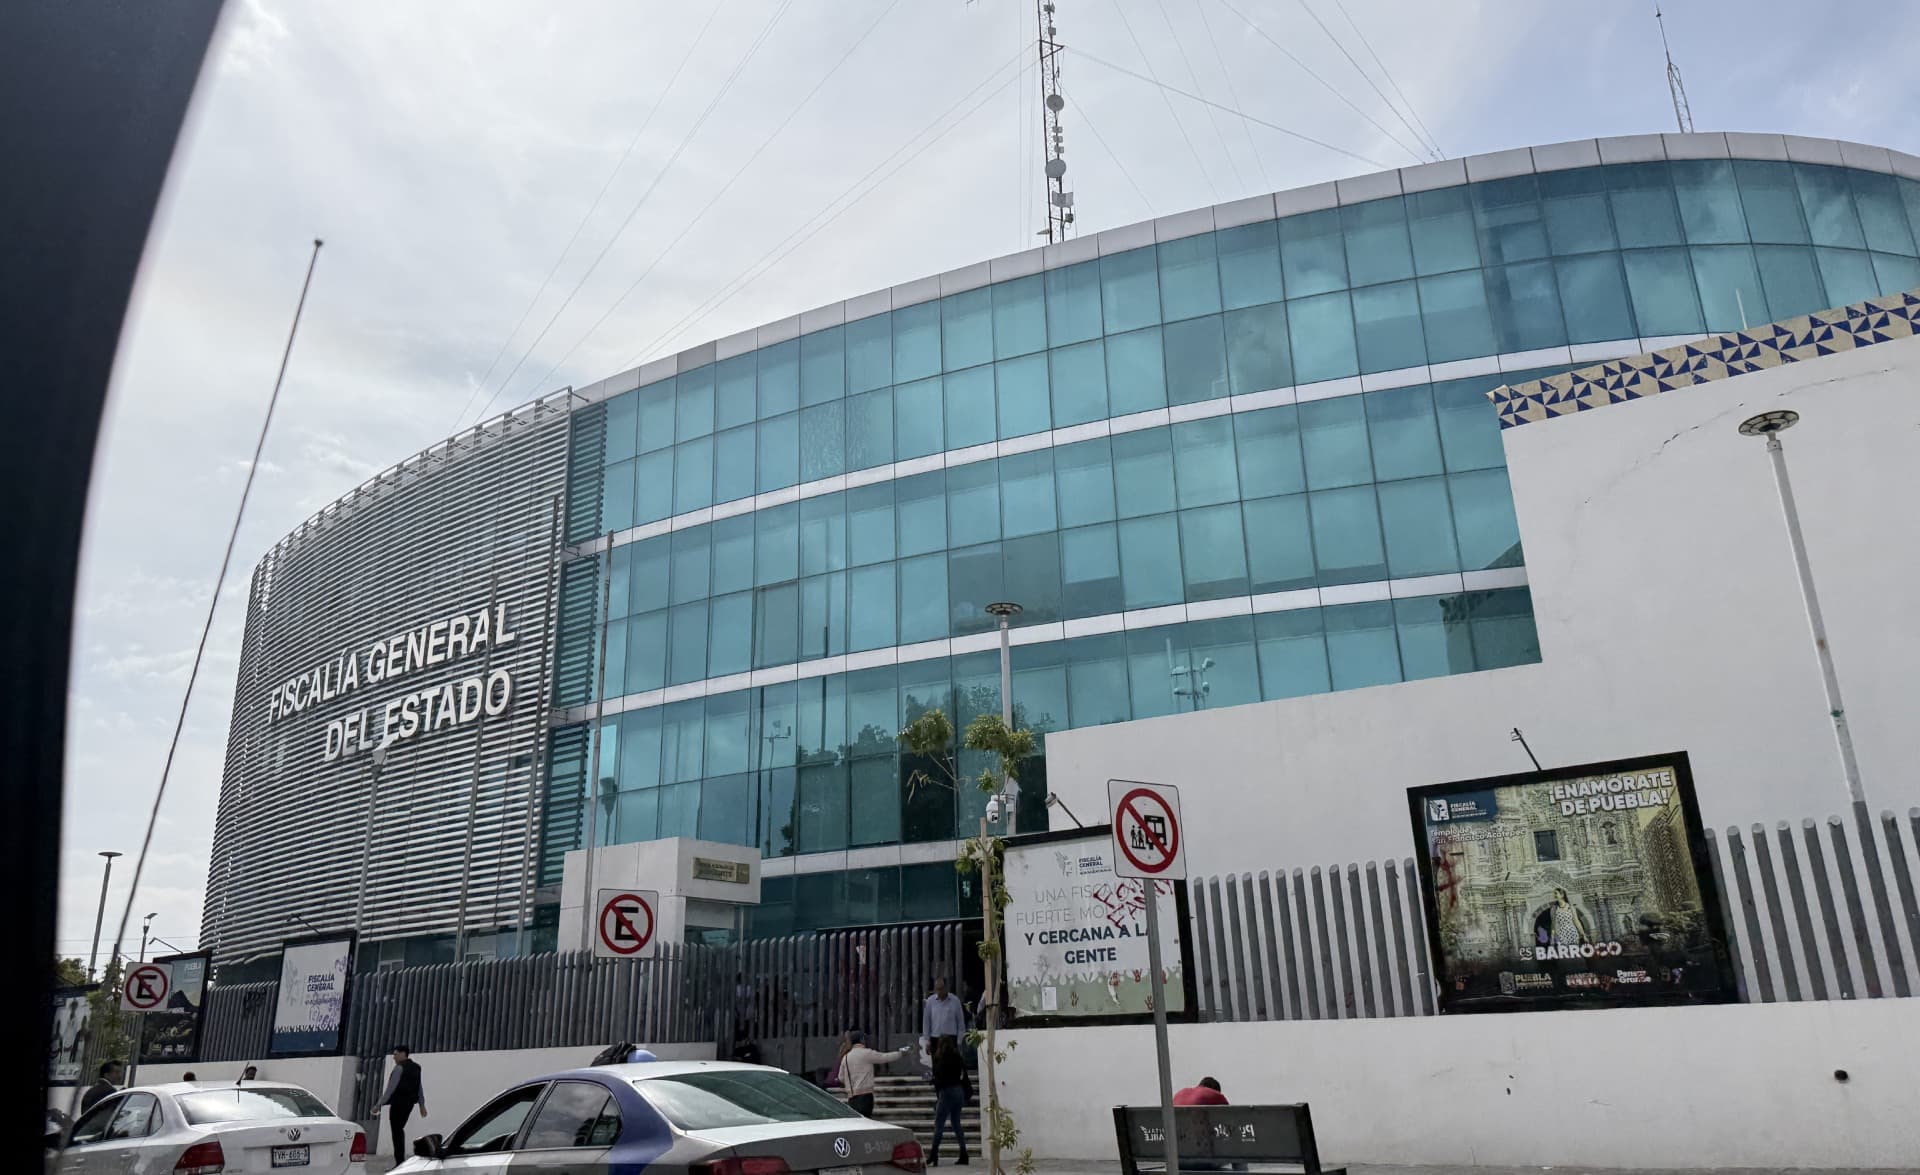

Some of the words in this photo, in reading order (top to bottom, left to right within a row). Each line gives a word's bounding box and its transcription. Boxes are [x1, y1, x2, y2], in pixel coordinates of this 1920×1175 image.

[268, 648, 360, 724] FISCALÍA
[367, 602, 516, 684] GENERAL
[324, 706, 373, 762] DEL
[383, 668, 513, 742] ESTADO
[1550, 772, 1672, 804] ¡ENAMÓRATE
[1561, 800, 1587, 817] DE
[1590, 789, 1669, 813] PUEBLA!
[1035, 887, 1065, 903] UNA
[1016, 909, 1076, 926] FUERTE,
[1024, 932, 1034, 946] Y
[1039, 926, 1115, 945] CERCANA
[1119, 924, 1131, 938] A
[1064, 947, 1117, 964] GENTE
[1535, 941, 1622, 961] BARROCO
[1515, 972, 1552, 983] PUEBLA
